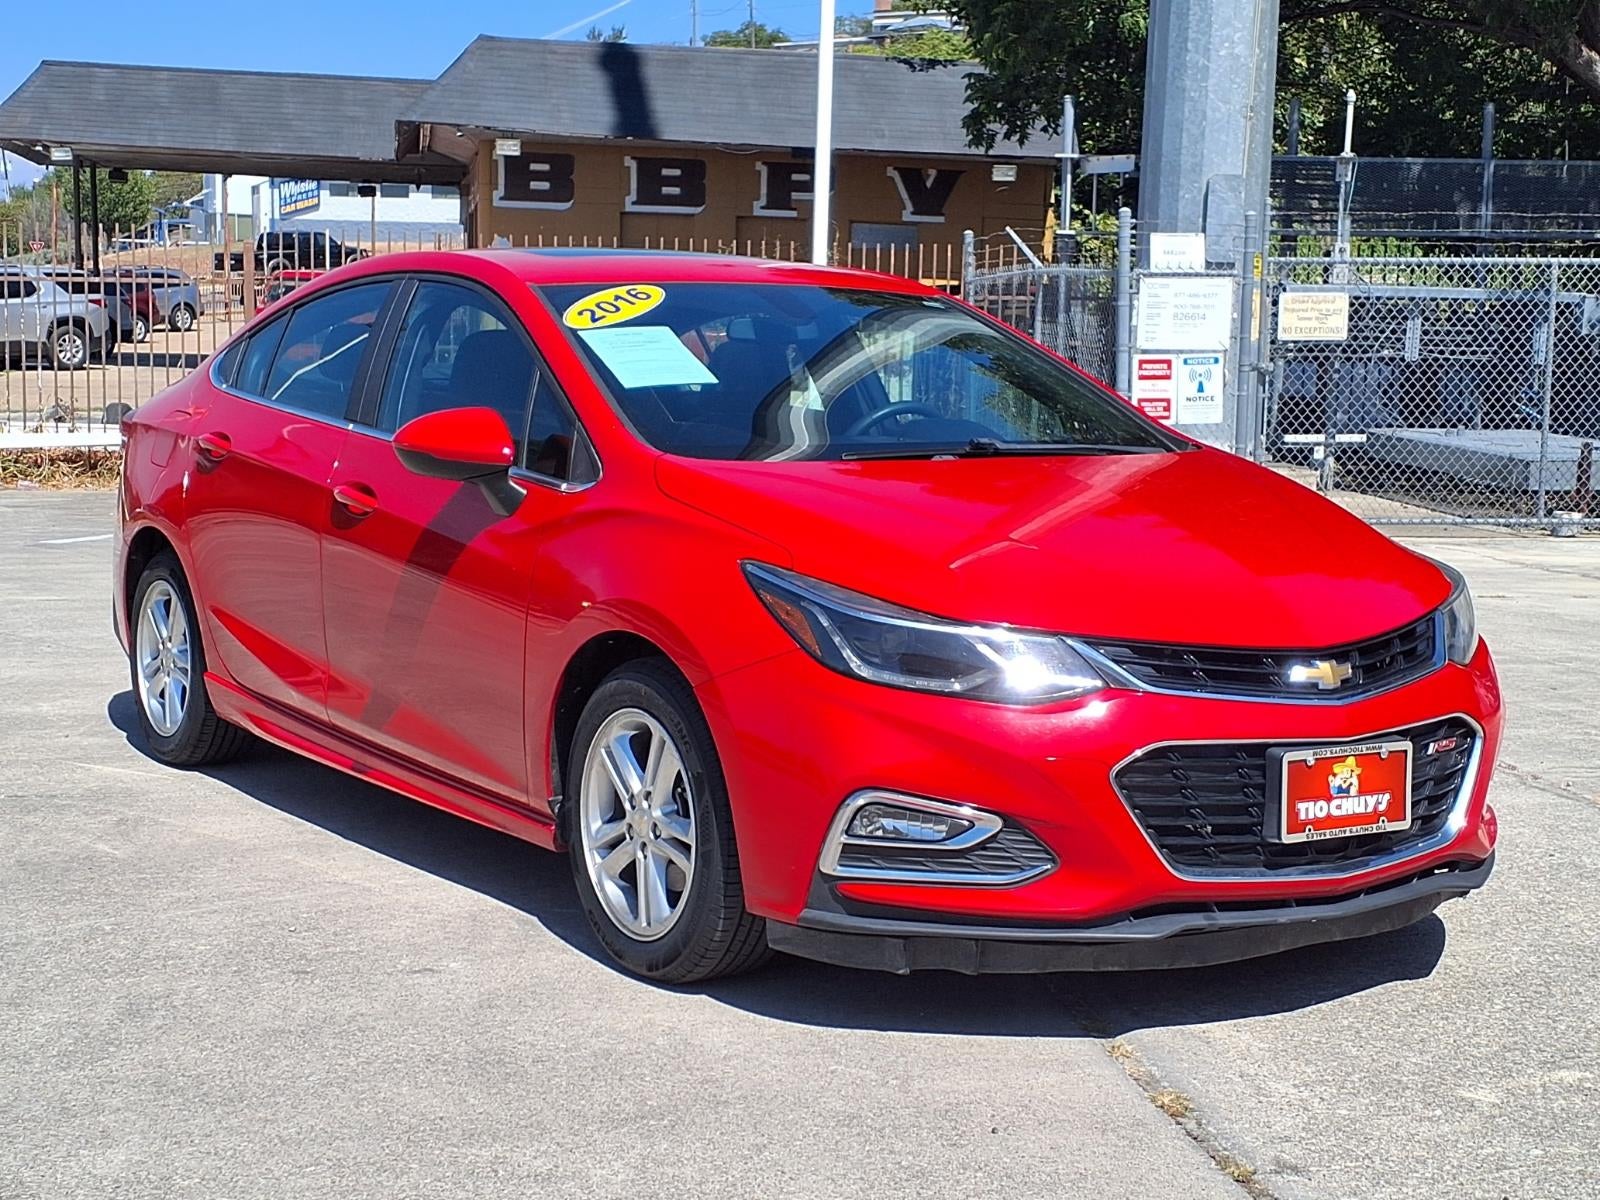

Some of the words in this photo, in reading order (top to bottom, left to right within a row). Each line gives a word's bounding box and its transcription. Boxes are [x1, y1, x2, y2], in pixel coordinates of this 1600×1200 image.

[280, 179, 318, 199] Whistle
[281, 189, 318, 205] EXPRESS
[281, 203, 296, 214] CAR
[296, 197, 318, 210] WASH
[577, 287, 652, 323] 2016
[1172, 312, 1207, 321] 826614
[1282, 327, 1292, 335] NO
[1294, 326, 1343, 335] EXCEPTIONS!
[1185, 395, 1215, 403] NOTICE
[1312, 744, 1383, 757] WWW.TIOCHUYS.COM
[1329, 828, 1347, 837] AUTO
[1375, 824, 1387, 832] TIO
[1305, 831, 1327, 840] SALES
